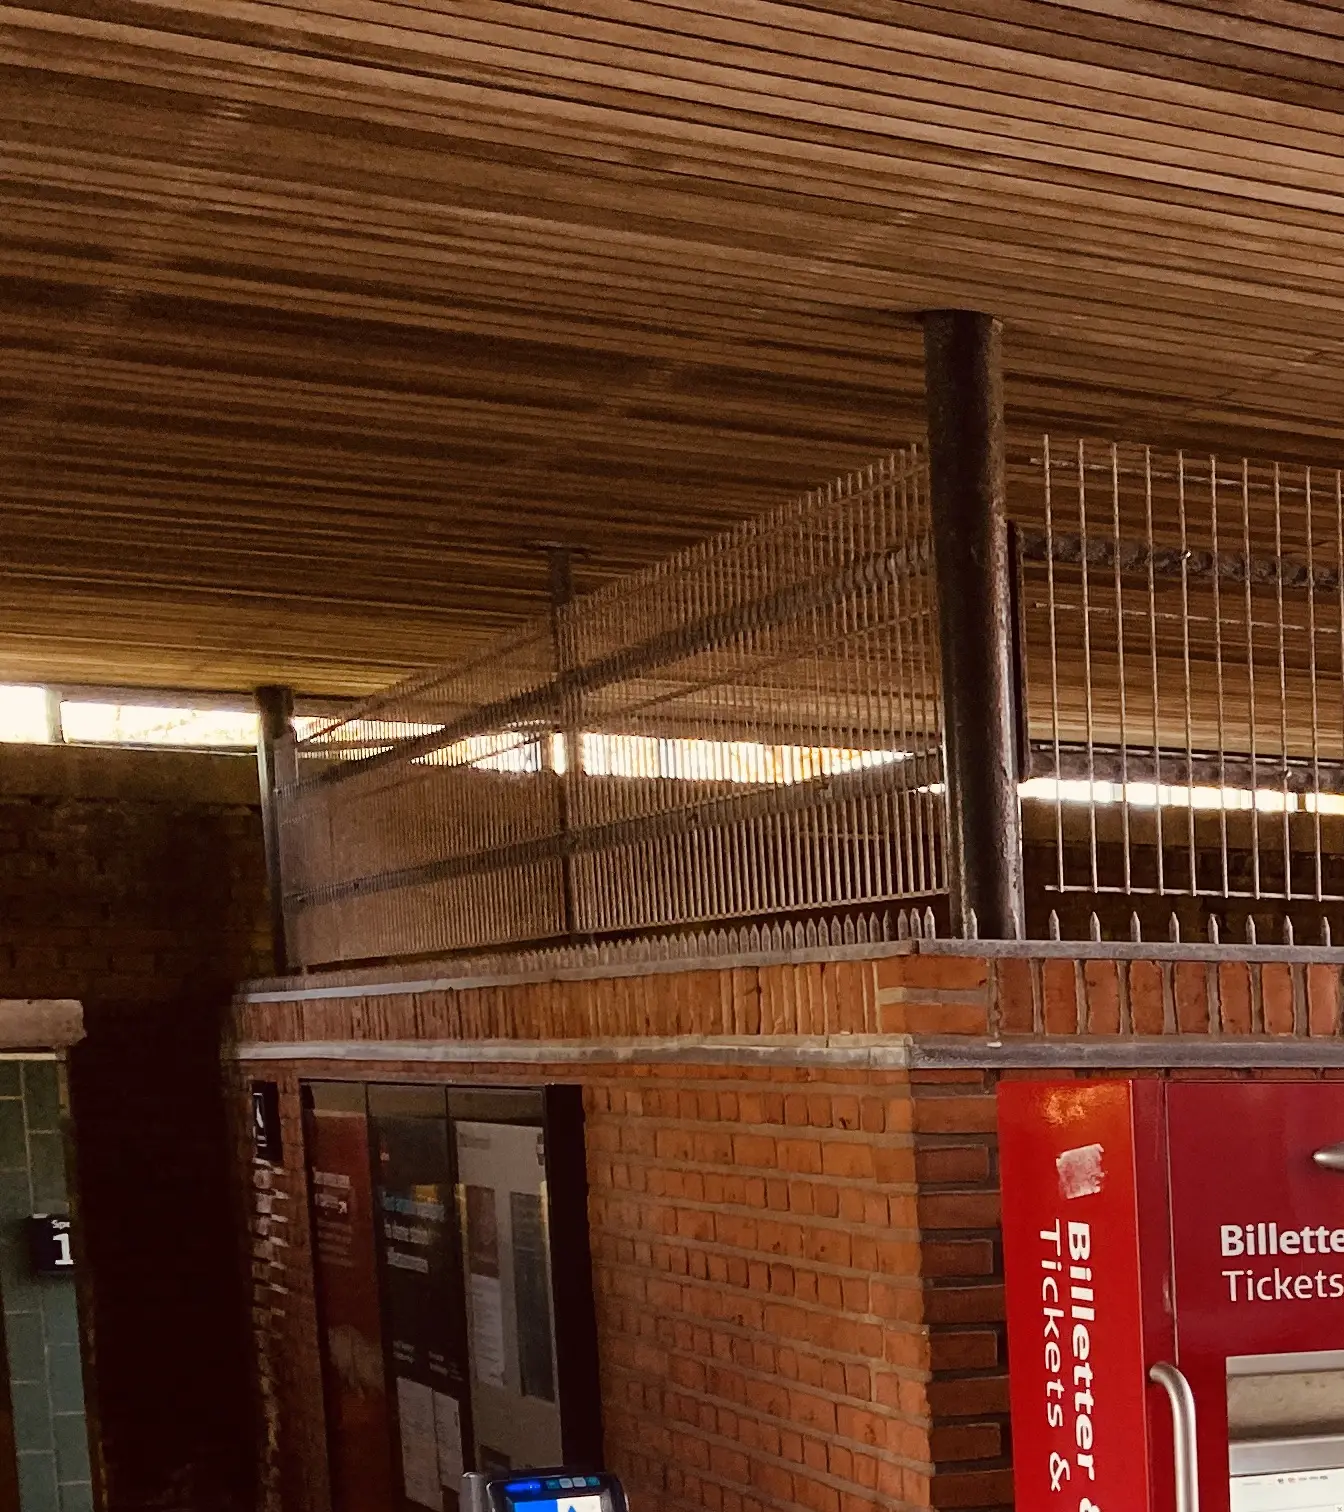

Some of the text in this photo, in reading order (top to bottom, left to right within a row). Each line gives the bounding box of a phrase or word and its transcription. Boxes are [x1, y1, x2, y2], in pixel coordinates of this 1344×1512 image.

[1040, 1218, 1065, 1428] Tickets
[1222, 1268, 1344, 1301] Tickets
[1067, 1220, 1095, 1482] Billetter
[1050, 1451, 1071, 1492] &
